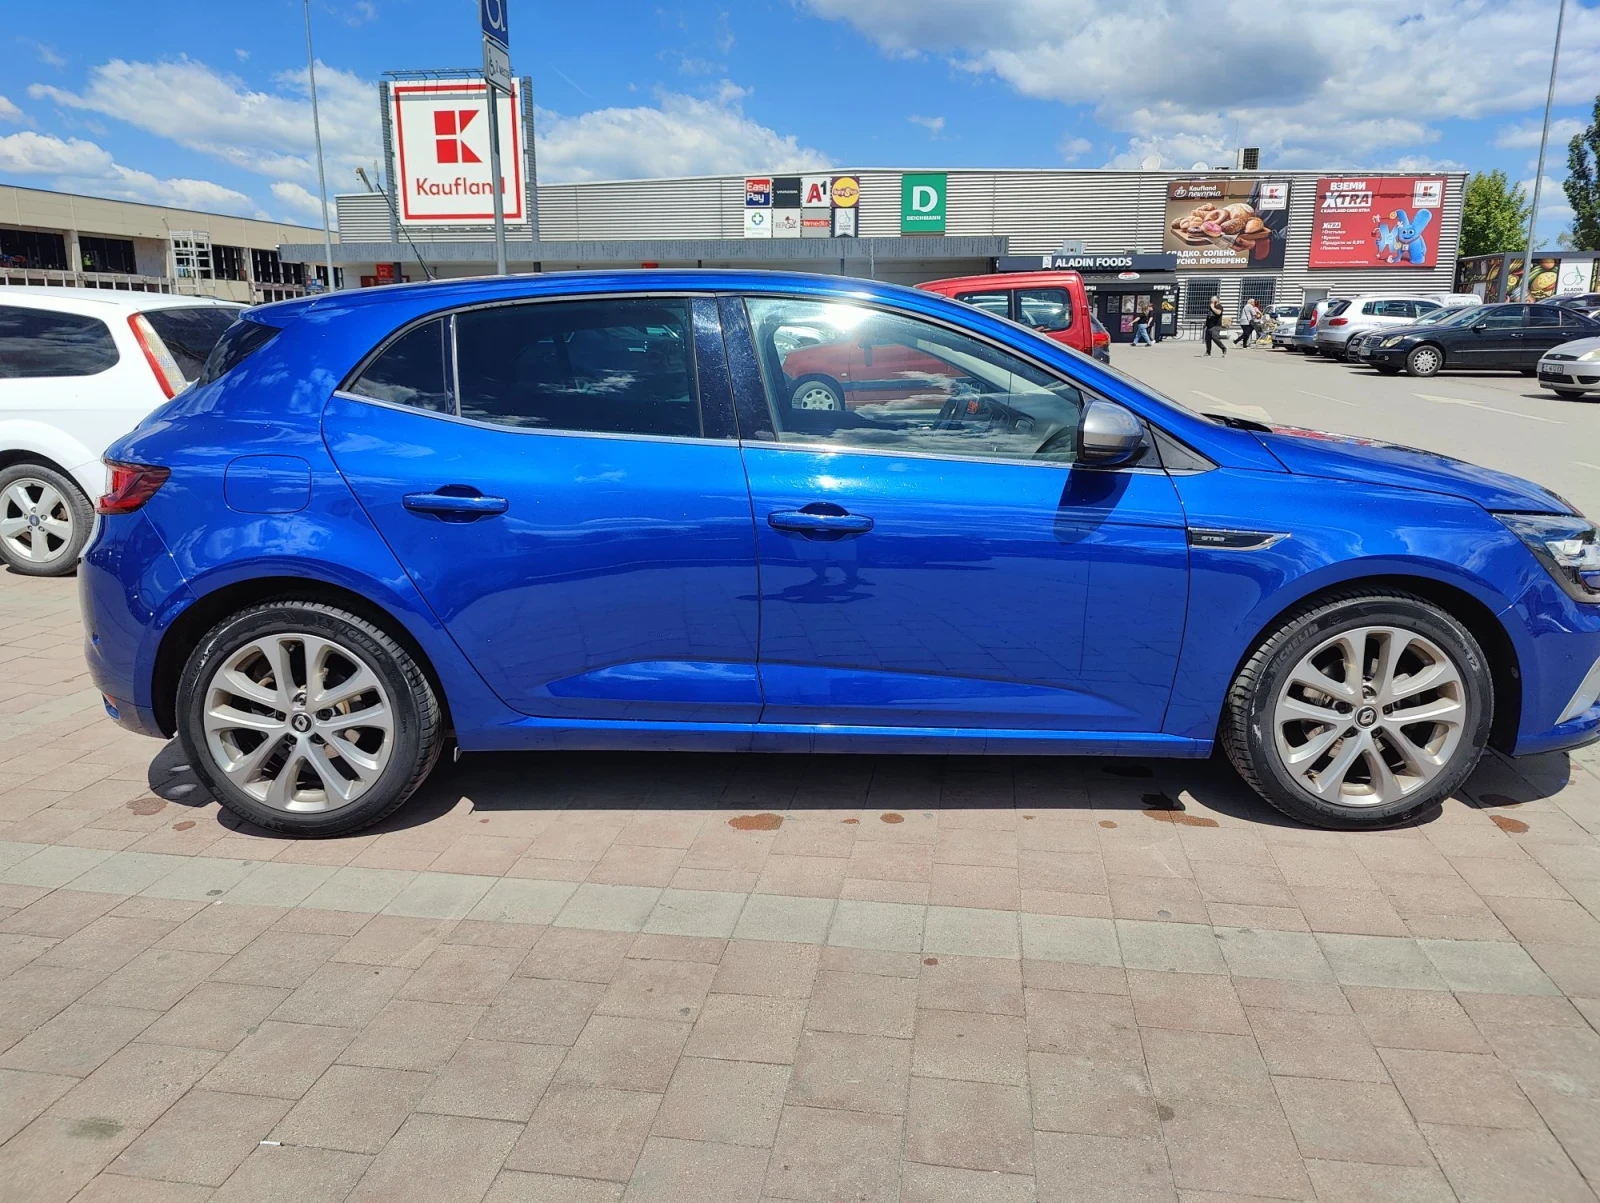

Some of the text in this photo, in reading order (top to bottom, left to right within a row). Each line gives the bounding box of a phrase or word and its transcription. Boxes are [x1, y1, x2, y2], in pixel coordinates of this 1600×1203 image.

[746, 183, 770, 193] Easy
[1330, 182, 1366, 190] ВЗЕМИ
[806, 181, 827, 204] A1
[747, 193, 765, 203] Pay
[912, 185, 939, 213] D
[1321, 192, 1372, 207] XTRA
[1203, 249, 1236, 257] СОЛЕНО.
[1055, 257, 1132, 267] ALADIN FOODS
[1199, 256, 1248, 264] ПРОВЕРЕНО.
[1269, 624, 1319, 674] MICHELIN
